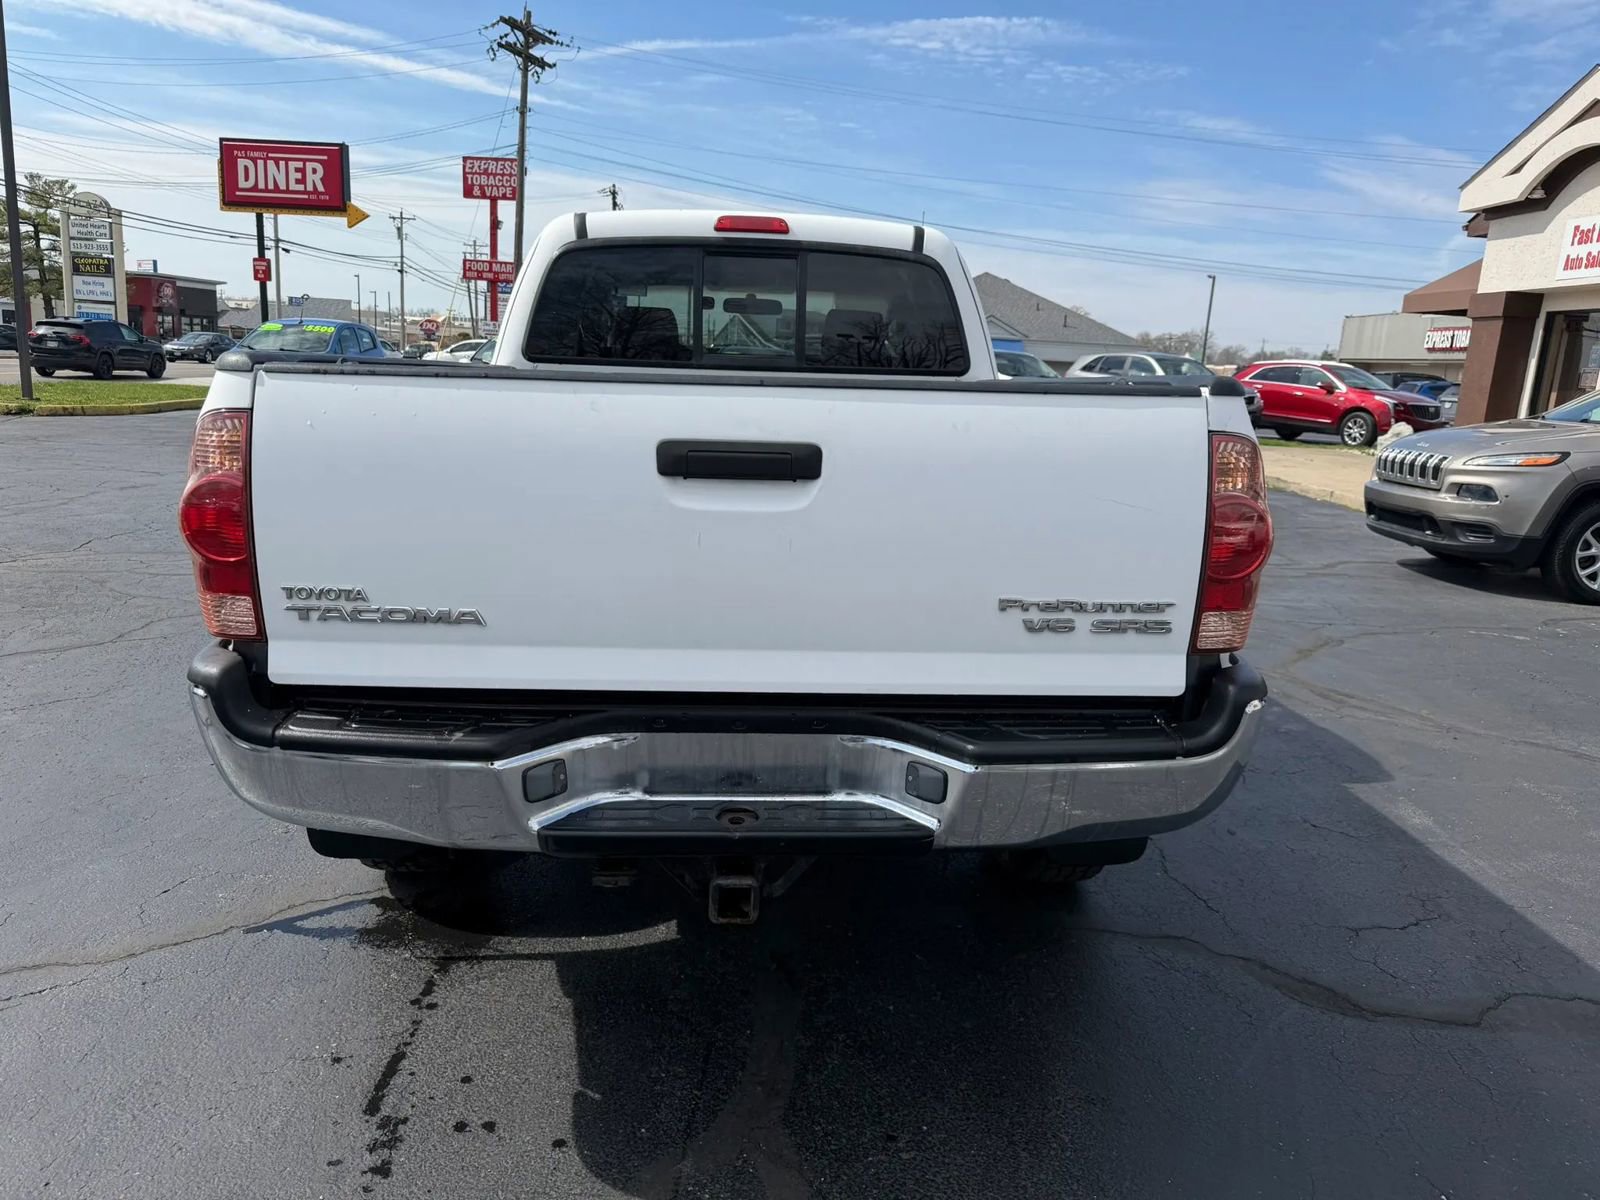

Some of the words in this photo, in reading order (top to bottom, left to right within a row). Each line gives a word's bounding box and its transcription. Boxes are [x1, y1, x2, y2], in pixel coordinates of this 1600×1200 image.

[465, 159, 518, 174] EXPRESS
[237, 158, 325, 193] DINER
[466, 174, 518, 187] TOBACCO
[472, 185, 482, 197] &
[484, 186, 513, 198] VAPE
[71, 221, 89, 229] United
[89, 222, 107, 230] Hearts
[95, 230, 108, 238] Care
[1570, 222, 1596, 247] Fast
[74, 257, 109, 265] CLEOPATRA
[465, 261, 490, 271] FOOD
[492, 263, 514, 273] MAR
[1562, 253, 1584, 271] Auto
[1584, 250, 1600, 270] Sal
[79, 264, 106, 273] NAILS
[498, 273, 514, 281] LOTTE
[1424, 330, 1453, 348] EXPRESS
[1452, 329, 1471, 348] TOBA
[281, 585, 369, 602] TOYOTA
[999, 597, 1176, 614] PreRunner
[284, 603, 488, 627] TACOMA
[1022, 618, 1076, 633] V6
[1089, 619, 1173, 635] SR5
